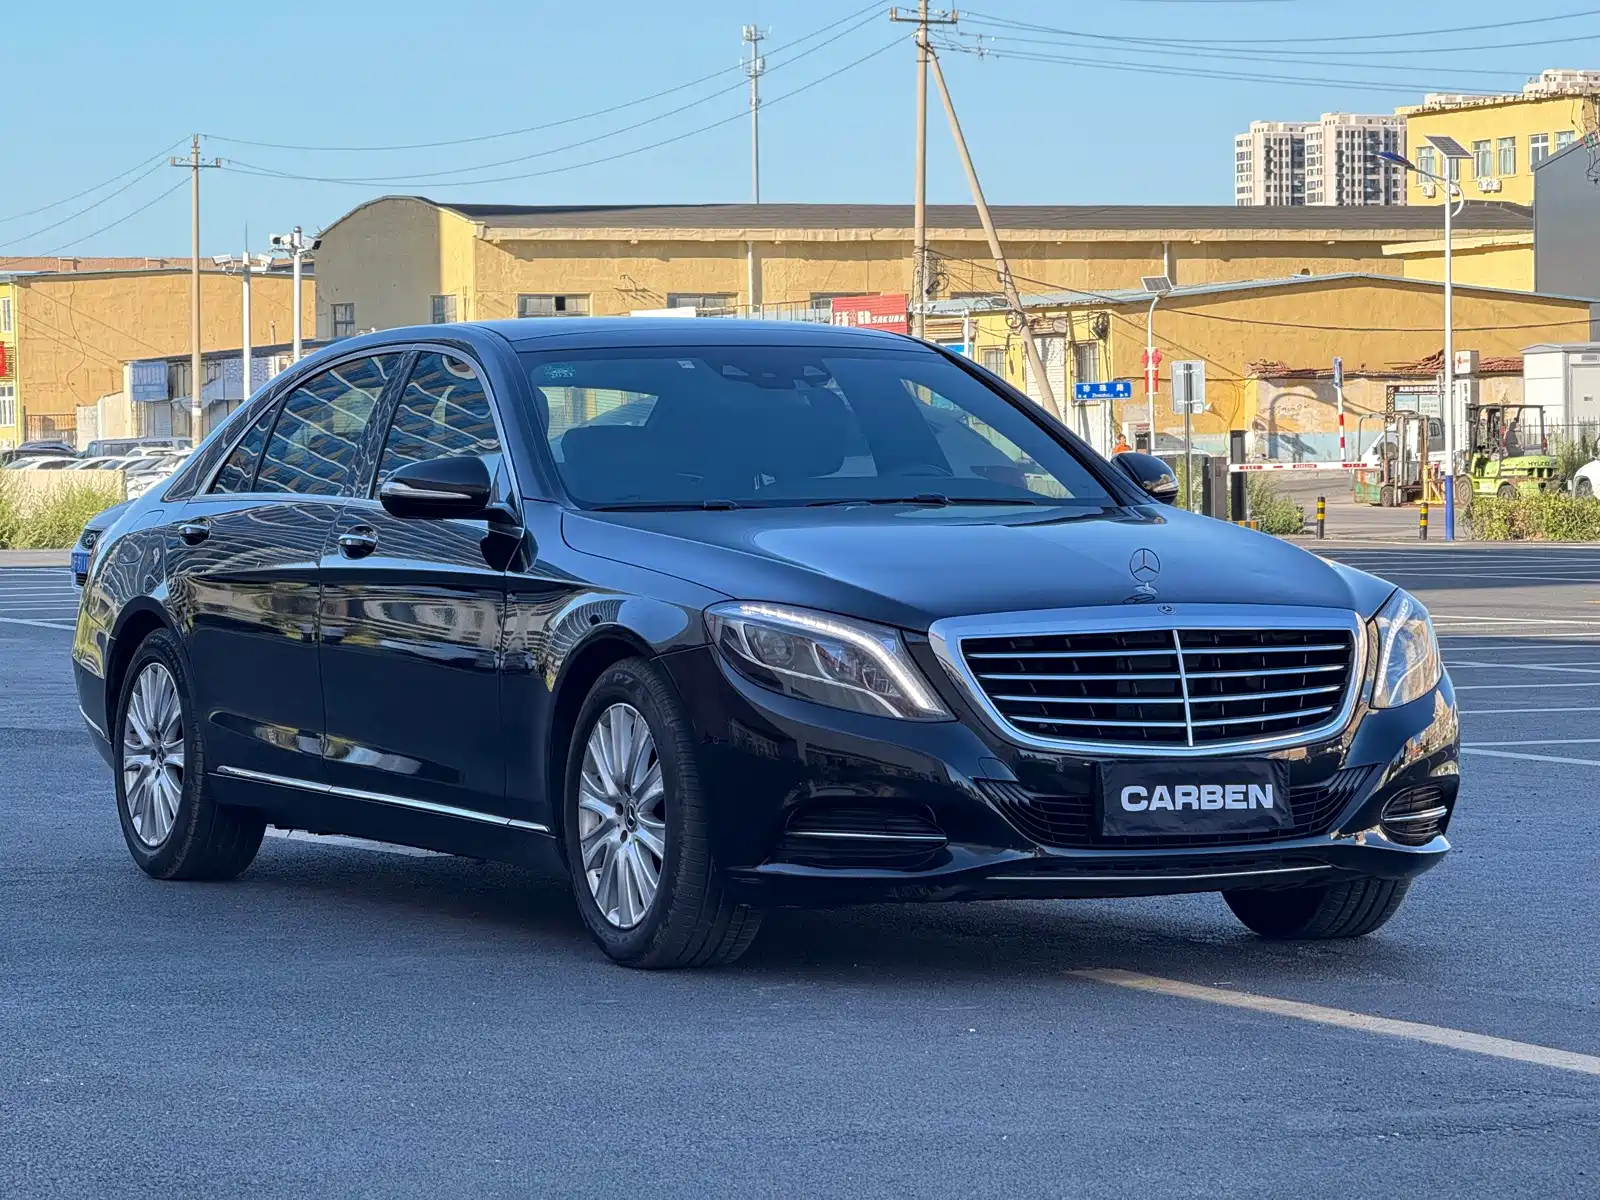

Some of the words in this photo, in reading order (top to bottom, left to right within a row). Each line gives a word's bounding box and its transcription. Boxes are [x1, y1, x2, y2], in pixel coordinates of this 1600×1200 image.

[871, 315, 905, 324] SAKURA
[1082, 383, 1124, 393] 珍珠路
[1120, 784, 1274, 812] CARBEN
